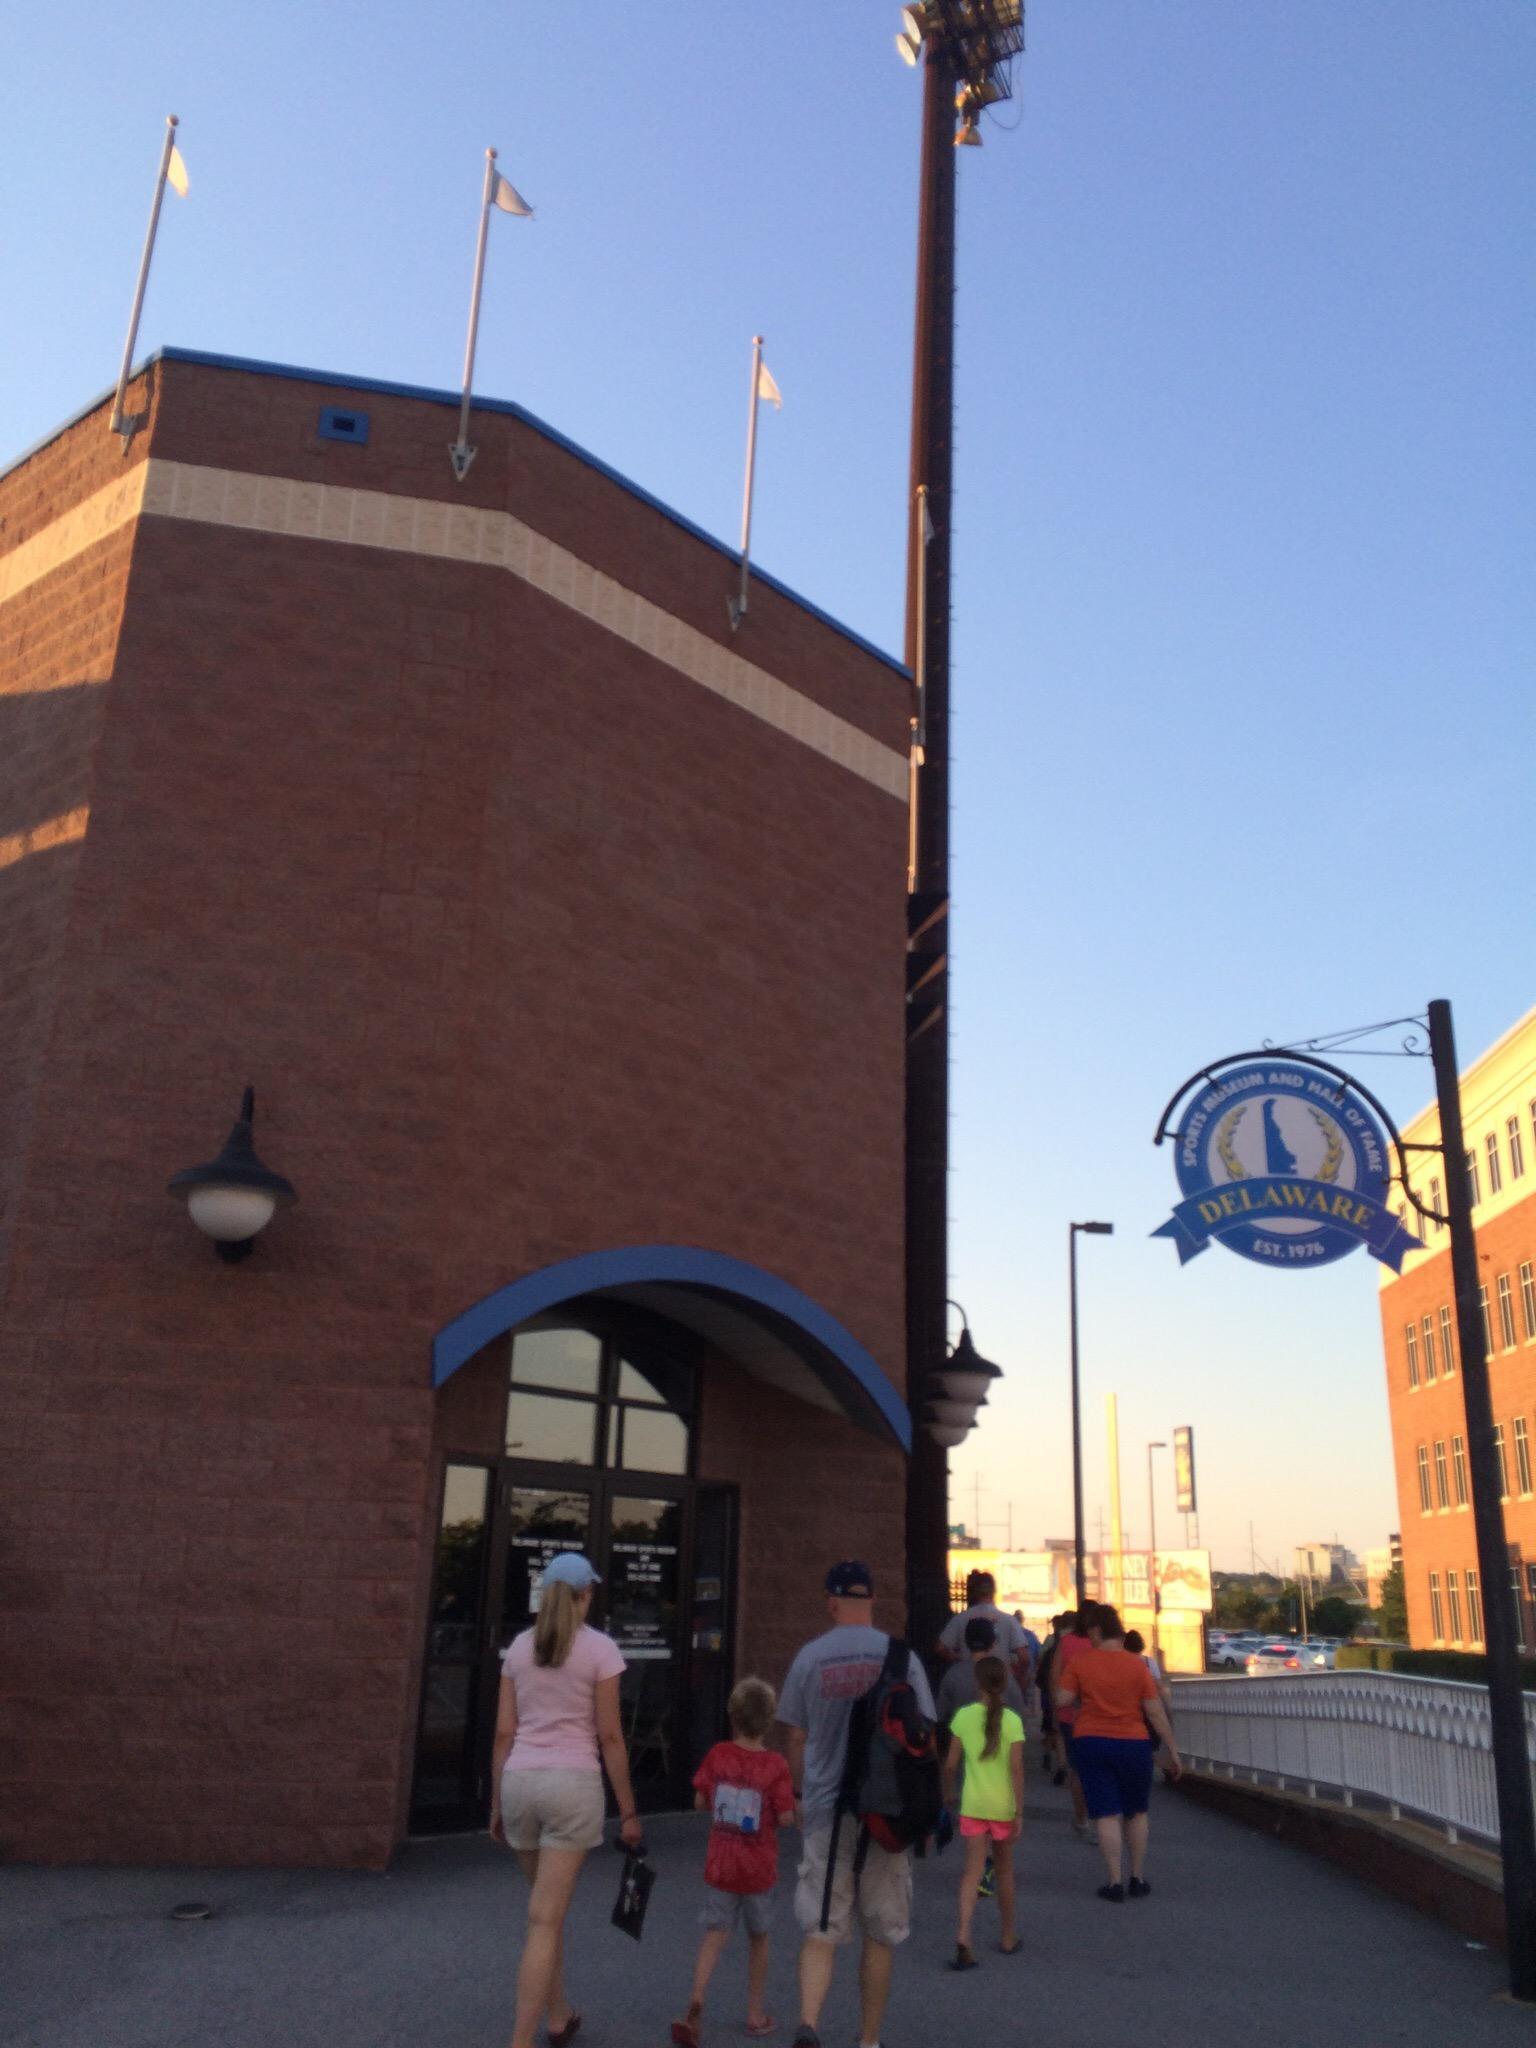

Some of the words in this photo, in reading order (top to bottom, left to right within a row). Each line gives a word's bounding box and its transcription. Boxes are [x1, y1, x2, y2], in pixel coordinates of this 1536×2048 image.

[1182, 1111, 1207, 1168] SPORTS
[1202, 1072, 1265, 1112] MUSEUM
[1268, 1071, 1304, 1088] AND
[1307, 1080, 1345, 1110] HALL
[1345, 1107, 1367, 1127] OF
[1360, 1130, 1383, 1173] FAME
[1198, 1184, 1375, 1229] DELAWARE
[1253, 1239, 1285, 1258] EST.
[1288, 1241, 1326, 1258] 1976
